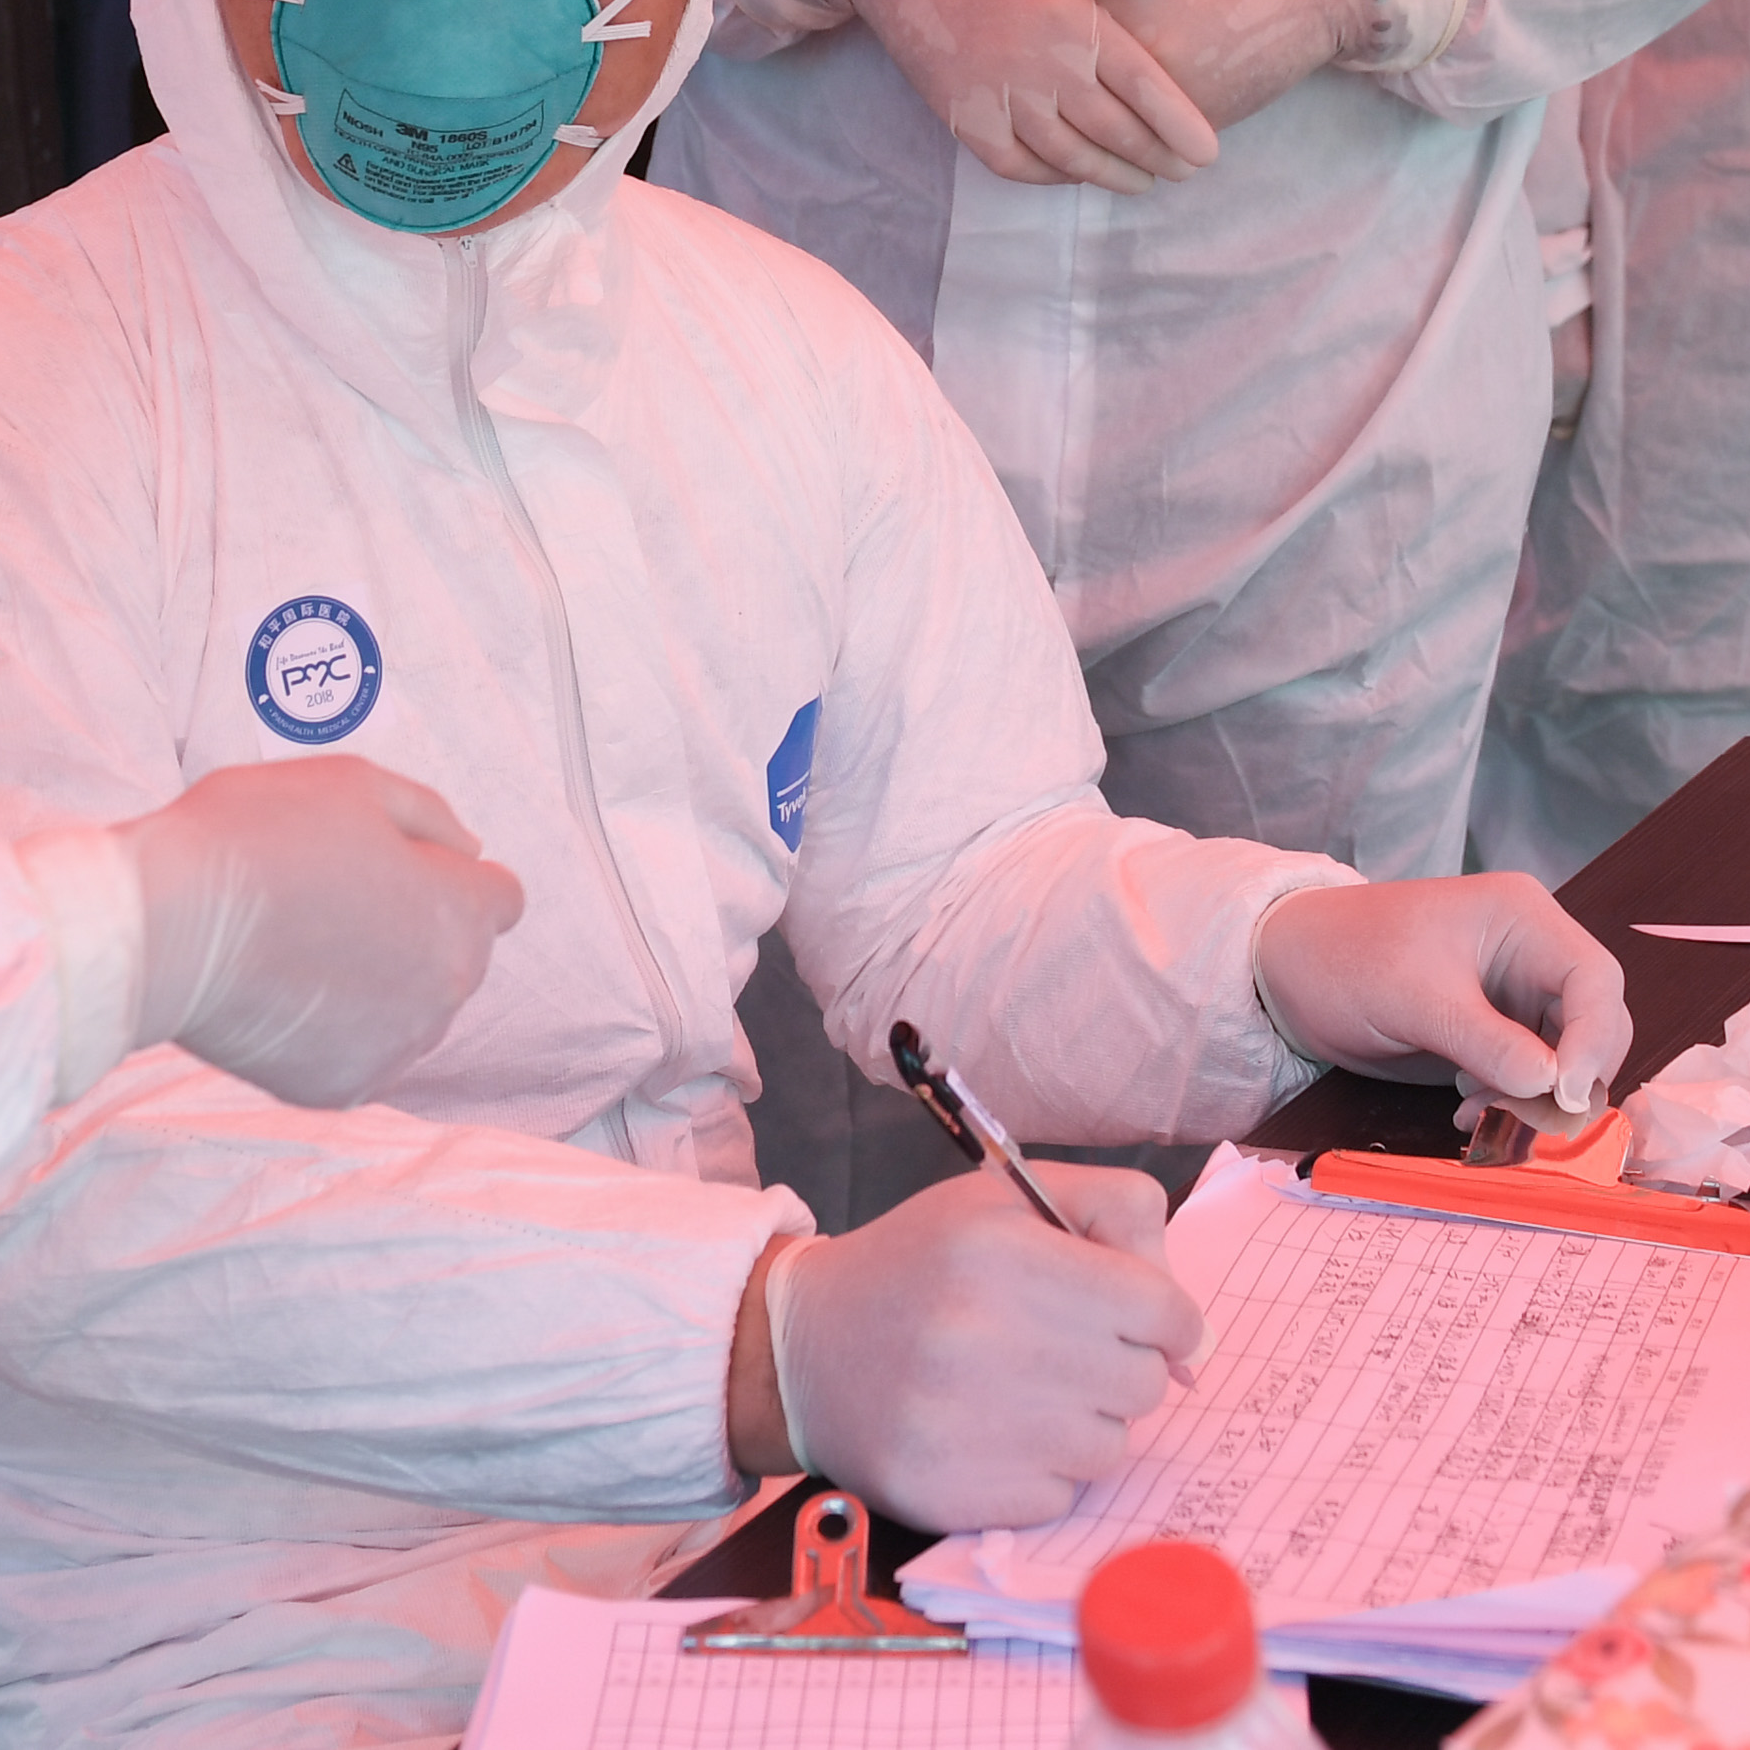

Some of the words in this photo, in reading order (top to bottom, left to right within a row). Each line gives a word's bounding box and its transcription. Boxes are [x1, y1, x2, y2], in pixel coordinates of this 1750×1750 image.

[343, 110, 384, 138] NIOSH
[395, 122, 429, 141] 3M
[439, 130, 488, 144] 1860S
[411, 140, 439, 154] N95
[466, 140, 487, 151] LOT
[382, 156, 405, 169] AND
[459, 160, 490, 172] MASK
[258, 602, 351, 650] 和平国际医院
[281, 653, 351, 697] PMC
[305, 689, 335, 708] 2018
[317, 716, 351, 736] MEDICAL
[351, 686, 370, 717] CENTER
